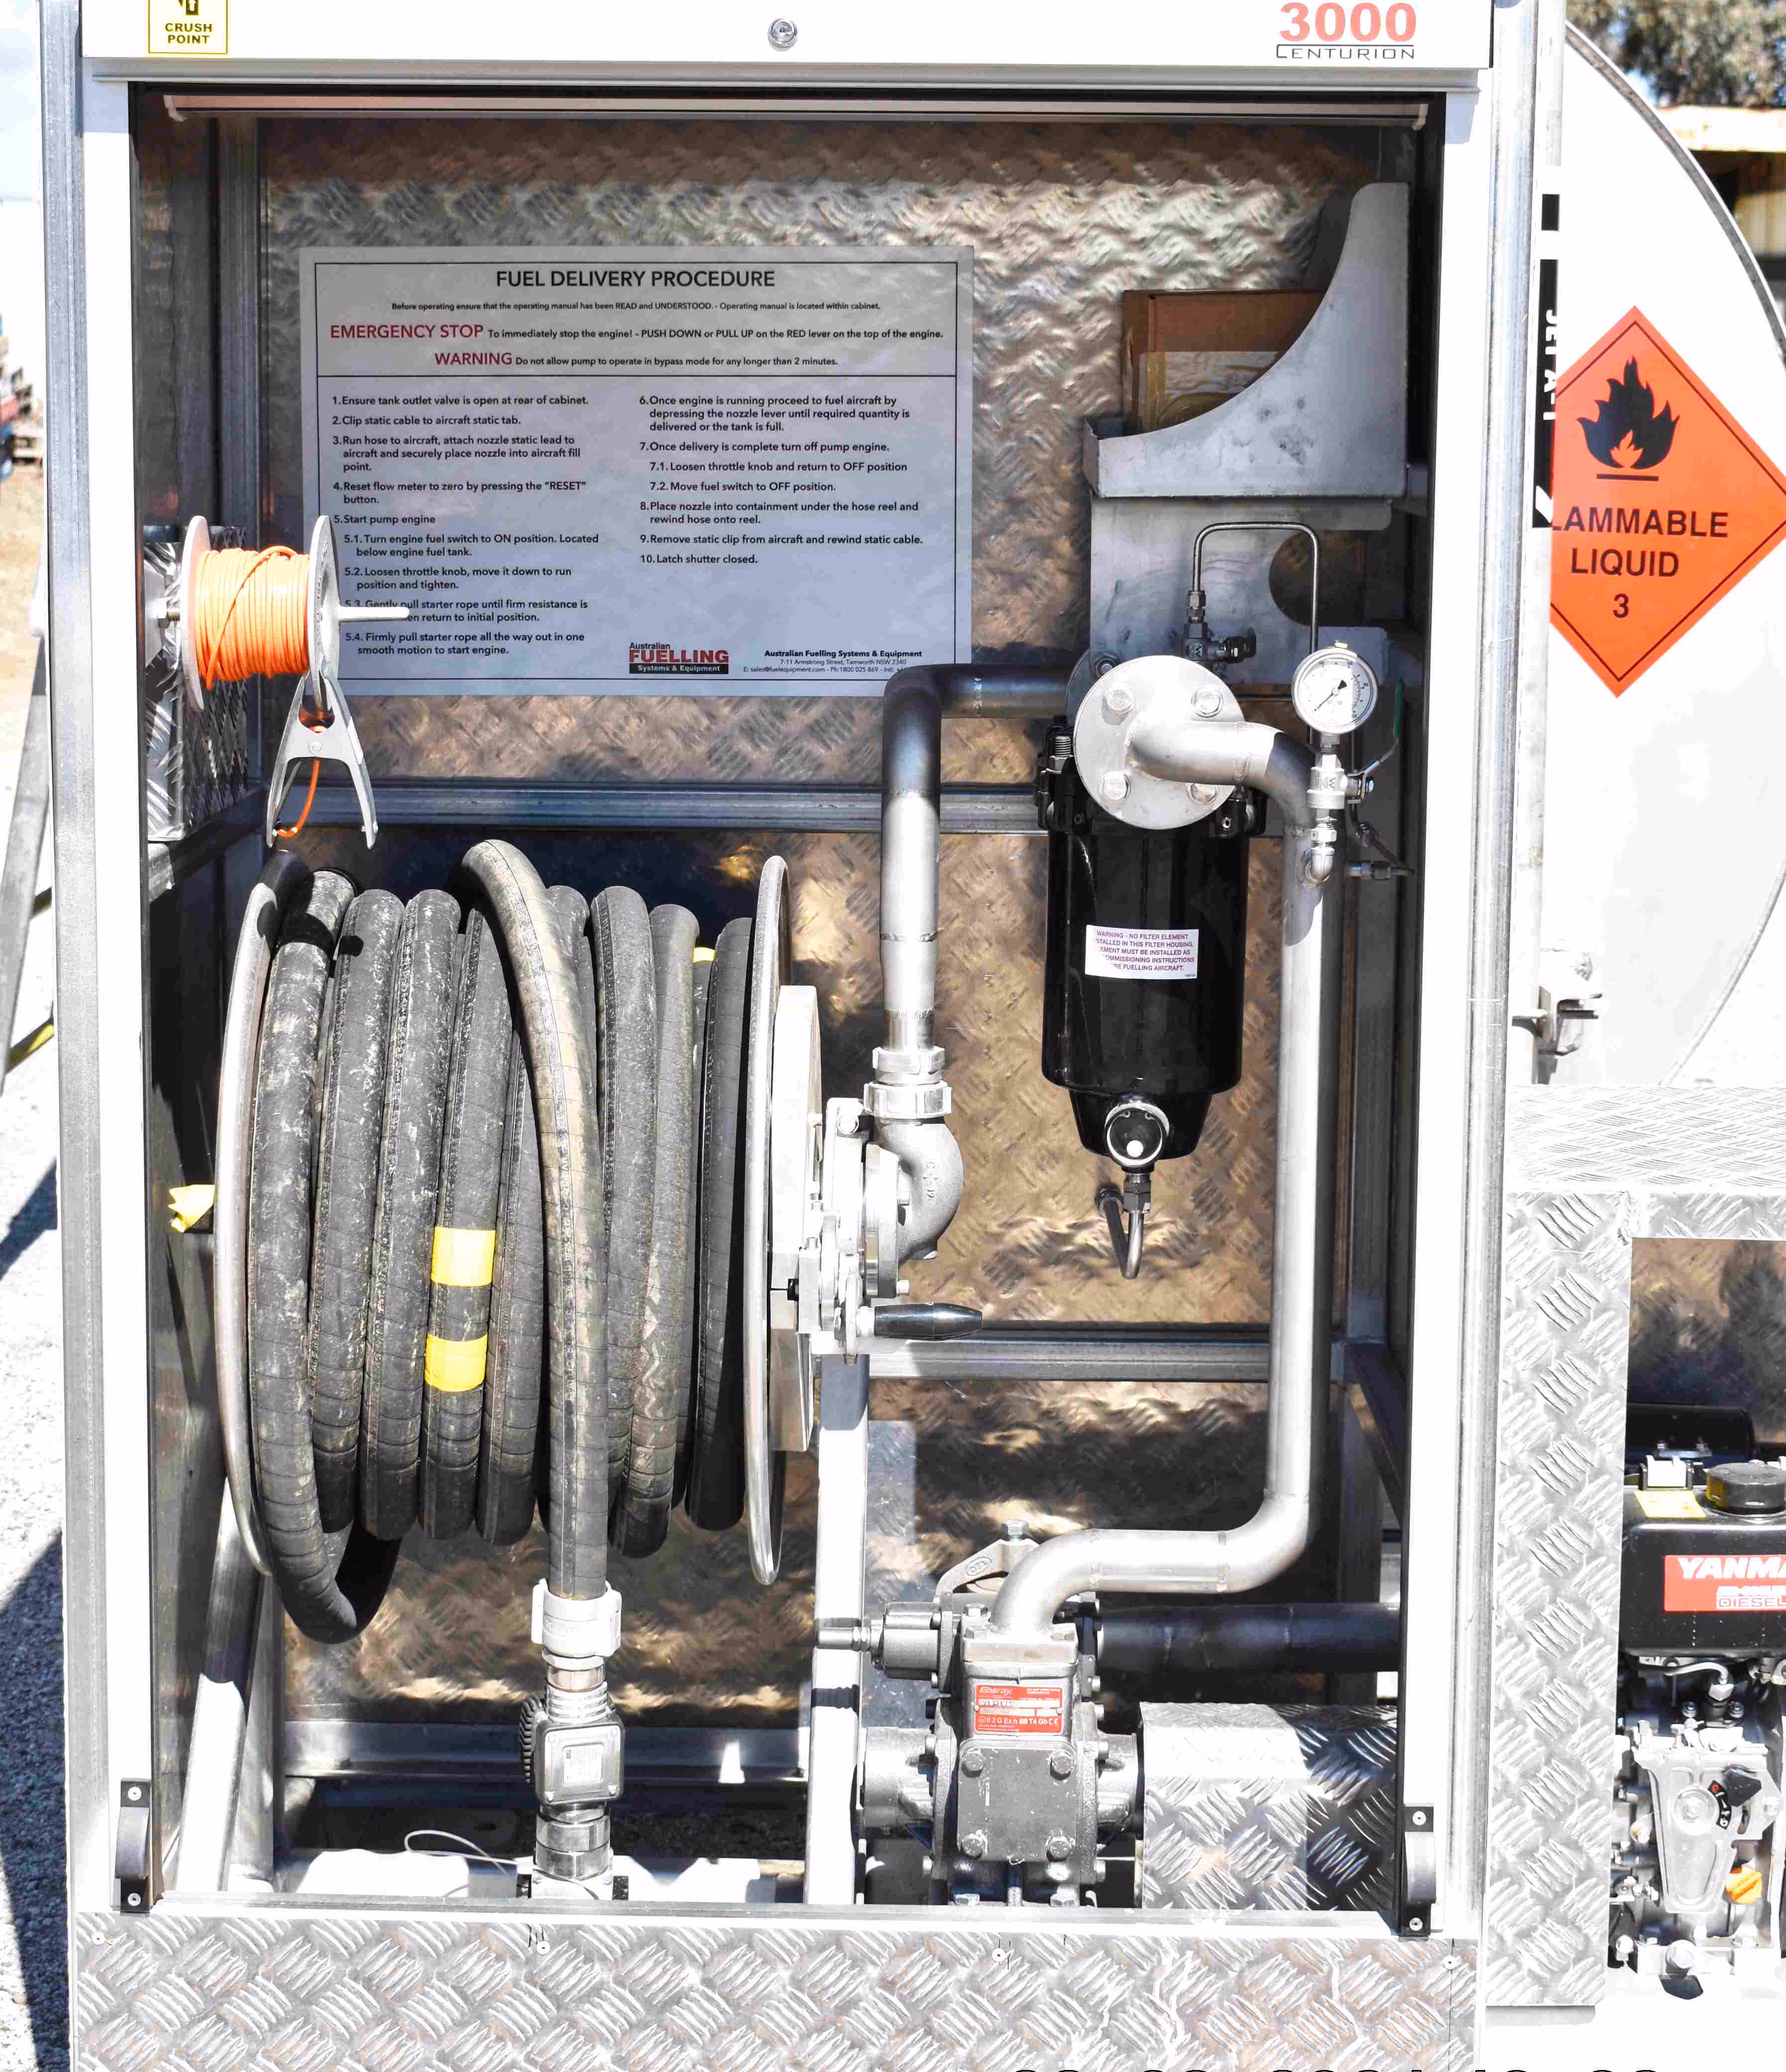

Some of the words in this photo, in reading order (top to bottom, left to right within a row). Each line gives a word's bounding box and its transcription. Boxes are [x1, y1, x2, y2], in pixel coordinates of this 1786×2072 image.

[165, 23, 213, 32] CRUSH
[1280, 2, 1417, 42] 3000
[168, 35, 210, 44] POINT
[1276, 44, 1414, 60] CENTURION
[496, 271, 546, 286] FUEL
[551, 271, 646, 286] DELIVERY
[651, 271, 775, 287] PROCEDURE
[418, 303, 455, 312] operating
[513, 303, 550, 311] operating
[719, 303, 758, 311] Operating
[330, 325, 436, 338] EMERGENCY
[440, 325, 484, 338] STOP
[487, 330, 500, 338] To
[501, 329, 558, 340] immediately
[559, 331, 580, 340] stop
[581, 329, 596, 338] the
[598, 330, 632, 340] engine!
[641, 329, 667, 338] PUSH
[669, 329, 702, 338] DOWN
[715, 330, 739, 338] PULL
[741, 330, 754, 338] UP
[769, 329, 785, 338] the
[808, 329, 831, 338] lever
[846, 329, 861, 338] the
[863, 331, 879, 340] top
[881, 329, 891, 338] of
[892, 329, 908, 338] the
[909, 329, 944, 340] engine.
[434, 353, 512, 365] WARNING
[546, 356, 570, 365] allow
[654, 357, 684, 367] bypass
[743, 357, 771, 366] longer
[649, 409, 705, 420] depressing
[707, 409, 723, 417] the
[726, 409, 758, 418] nozzle
[761, 409, 786, 417] lever
[788, 409, 810, 418] until
[813, 409, 855, 420] required
[858, 409, 900, 420] quantity
[902, 409, 910, 418] is
[343, 449, 378, 458] aircraft
[380, 449, 399, 458] and
[401, 449, 443, 460] securely
[445, 449, 472, 460] place
[474, 449, 506, 457] nozzle
[509, 449, 528, 457] into
[531, 448, 566, 457] aircraft
[568, 448, 581, 457] fill
[649, 482, 669, 490] 7.2.
[670, 482, 698, 491] Move
[701, 482, 719, 491] fuel
[722, 482, 753, 491] switch
[769, 482, 791, 491] OFF
[793, 482, 836, 493] position.
[657, 554, 683, 563] Latch
[685, 554, 721, 563] shutter
[722, 554, 758, 563] closed.
[1571, 548, 1679, 577] LIQUID
[1613, 593, 1629, 618] 3
[357, 645, 395, 654] smooth
[472, 646, 509, 656] engine.
[629, 650, 729, 663] FUELLING
[1677, 1557, 1786, 1579] YANM
